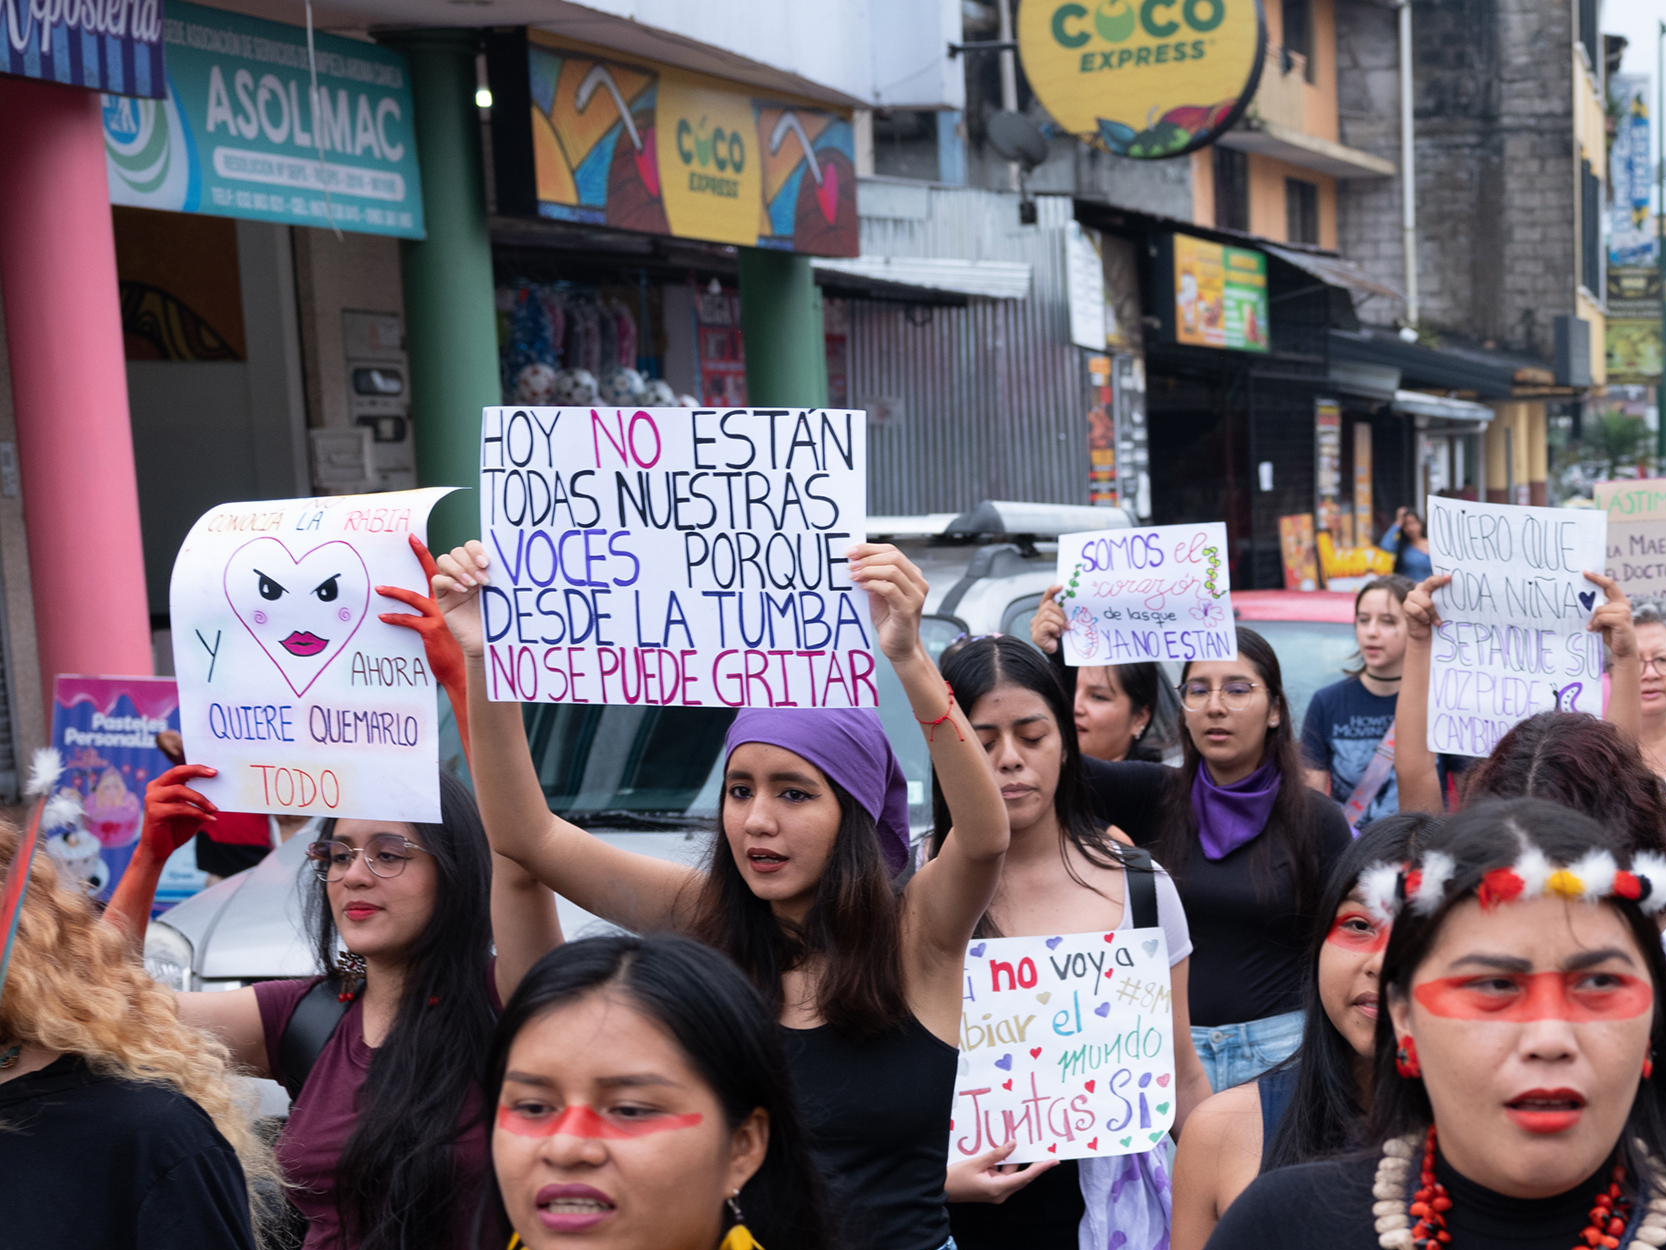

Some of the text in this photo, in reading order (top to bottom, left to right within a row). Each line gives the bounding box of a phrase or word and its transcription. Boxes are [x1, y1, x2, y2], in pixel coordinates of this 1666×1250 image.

[1079, 40, 1206, 74] EXPRESS
[205, 64, 405, 162] ASOLIMAC
[677, 117, 745, 175] COCO
[689, 171, 738, 198] EXPRESS
[484, 408, 853, 470] HOY NO ESTÁN
[296, 510, 323, 531] LA
[344, 508, 411, 533] RABIA
[482, 468, 839, 530] TODAS NUESTRAS
[490, 529, 852, 591] VOCES PORQUE
[1082, 532, 1207, 572] SOMOS el
[1522, 514, 1580, 573] QUE
[1435, 564, 1497, 612] TODA
[482, 586, 870, 650] DESDE LA TUMBA
[1104, 606, 1177, 628] de las que
[195, 629, 428, 687] Y AHORA
[1101, 629, 1230, 660] YA NO ESTAN
[1565, 632, 1604, 681] SU
[490, 645, 879, 708] NO SE PUEDE GRITAR
[1432, 667, 1540, 718] VOZ PUEDE
[91, 712, 168, 732] Pasteles
[209, 703, 418, 746] QUIERE QUEMARLO
[250, 764, 339, 808] TODO
[989, 956, 1038, 992] no
[1050, 951, 1105, 996] voy
[1115, 947, 1135, 967] a
[959, 1011, 1038, 1053] biar
[1052, 989, 1082, 1037] el
